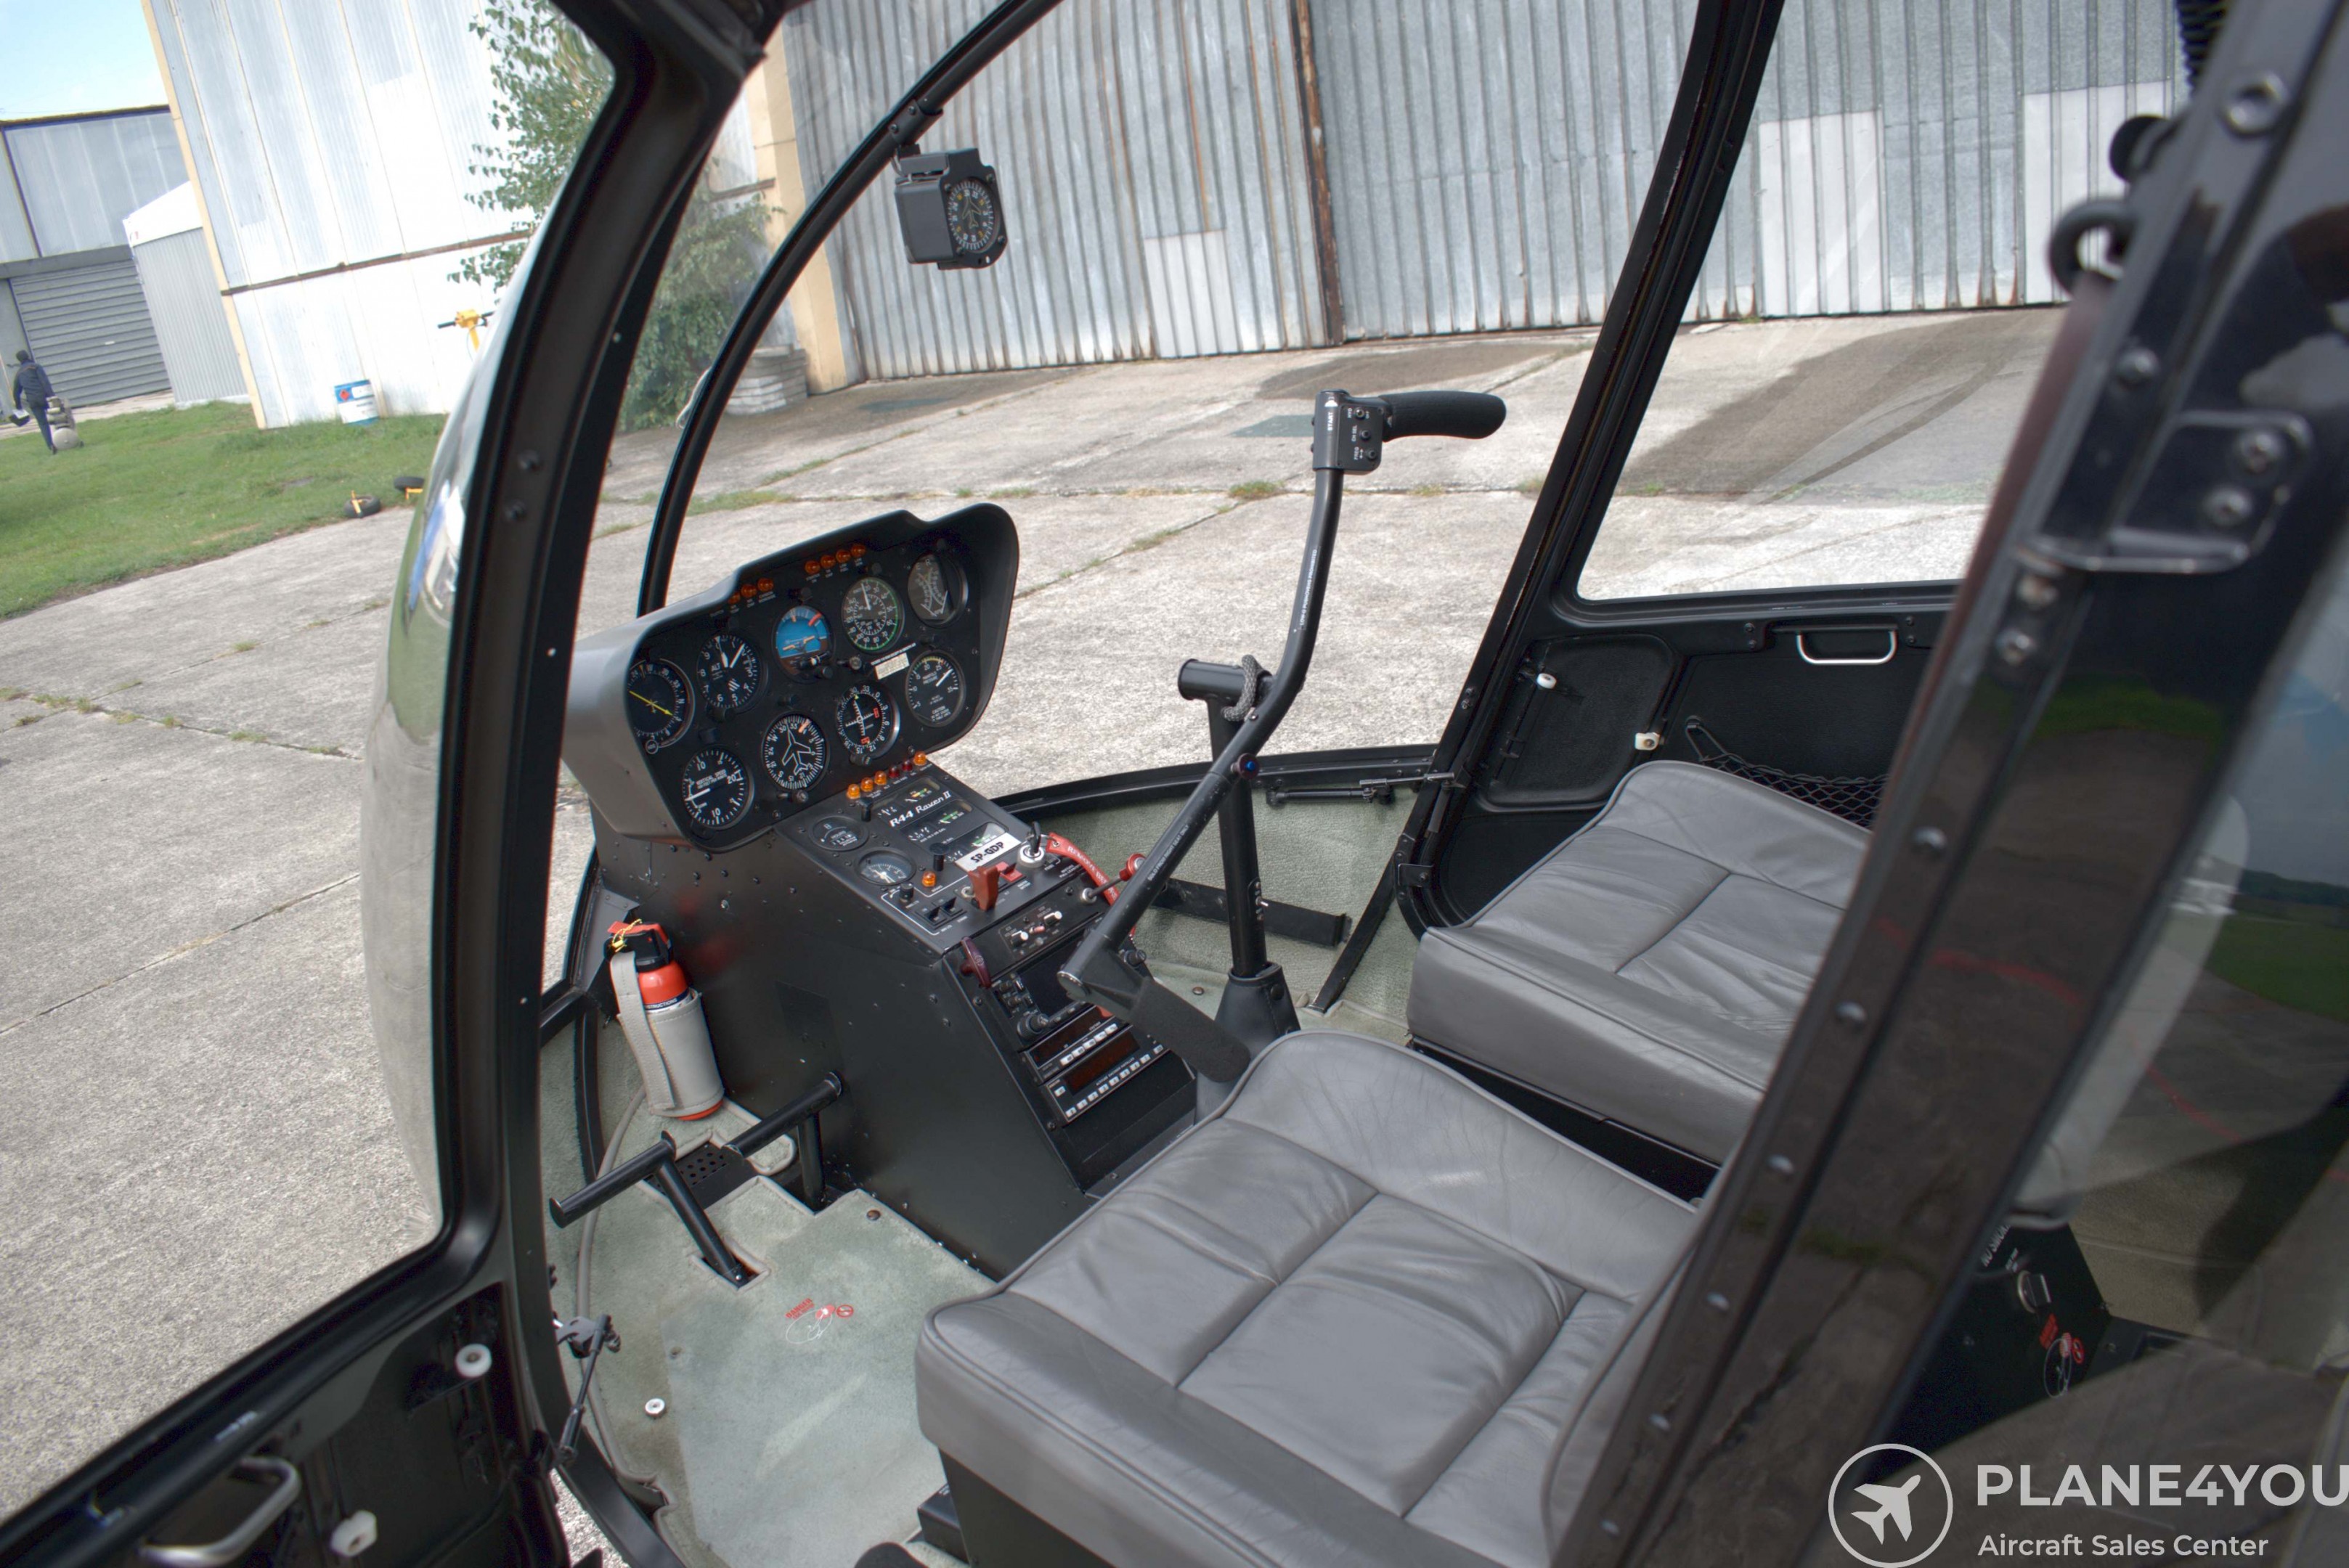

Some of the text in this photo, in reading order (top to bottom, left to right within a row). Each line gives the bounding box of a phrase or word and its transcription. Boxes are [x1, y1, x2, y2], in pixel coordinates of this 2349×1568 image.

[711, 662, 721, 672] ALT
[717, 693, 724, 702] 6
[696, 761, 707, 772] 10
[726, 773, 737, 785] 20
[711, 807, 721, 818] 10
[889, 790, 952, 828] R44 Raven II
[970, 841, 1005, 863] SP-GDP
[1147, 825, 1189, 881] SOLO FROM RIGHT SEAT ONLY
